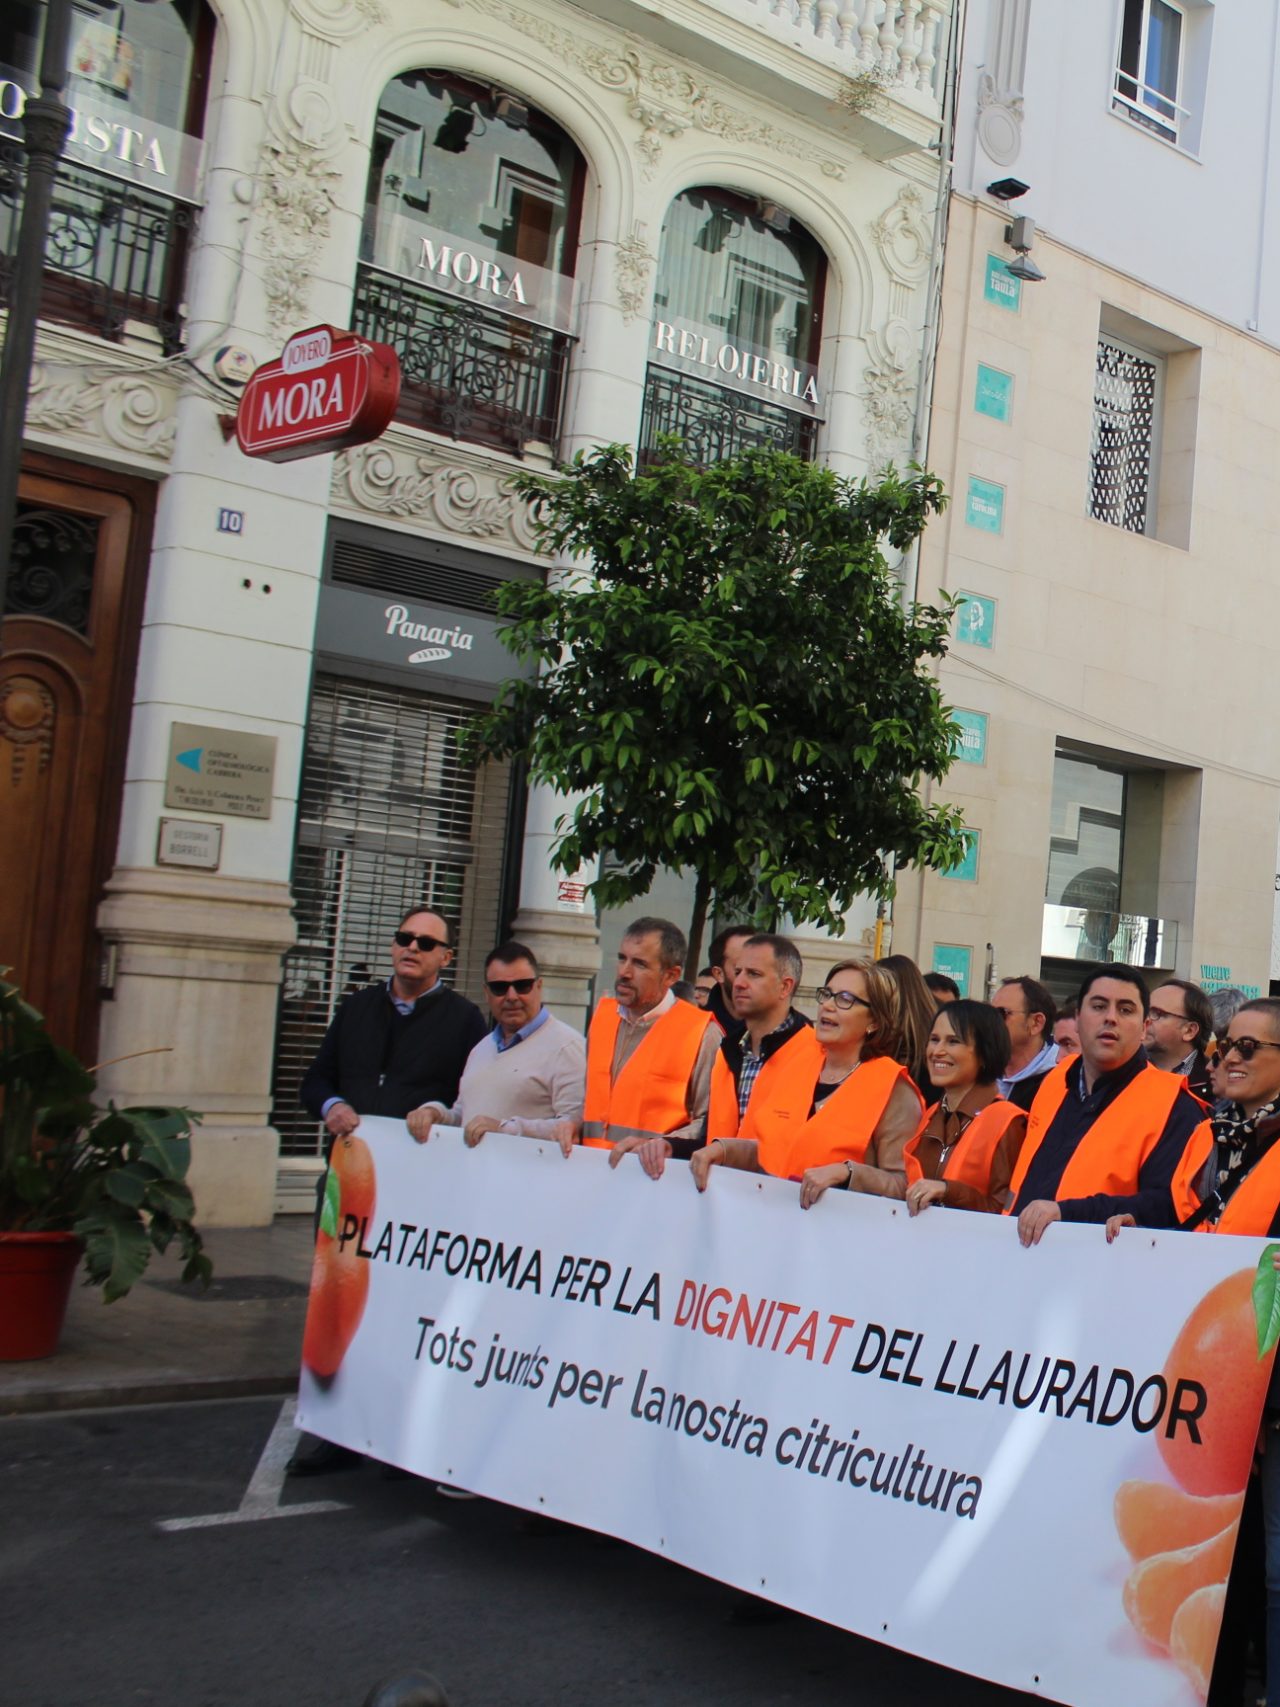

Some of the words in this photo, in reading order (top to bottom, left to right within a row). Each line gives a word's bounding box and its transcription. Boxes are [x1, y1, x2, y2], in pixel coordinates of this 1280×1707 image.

[417, 237, 528, 305] MORA
[287, 337, 329, 366] JOYERO
[656, 320, 820, 405] RELOJERIA
[258, 373, 344, 431] MORA
[221, 511, 241, 531] 10
[385, 605, 473, 650] Panaria
[338, 1213, 542, 1295] PLATAFORMA
[550, 1255, 612, 1306] PER
[613, 1266, 661, 1321] LA
[674, 1279, 855, 1365] DIGNITAT
[851, 1323, 924, 1387] DEL
[934, 1339, 1208, 1446] LLAURADOR
[415, 1317, 477, 1372] Tots
[474, 1333, 549, 1389] junts
[547, 1361, 624, 1409] per
[775, 1418, 983, 1520] citricultura
